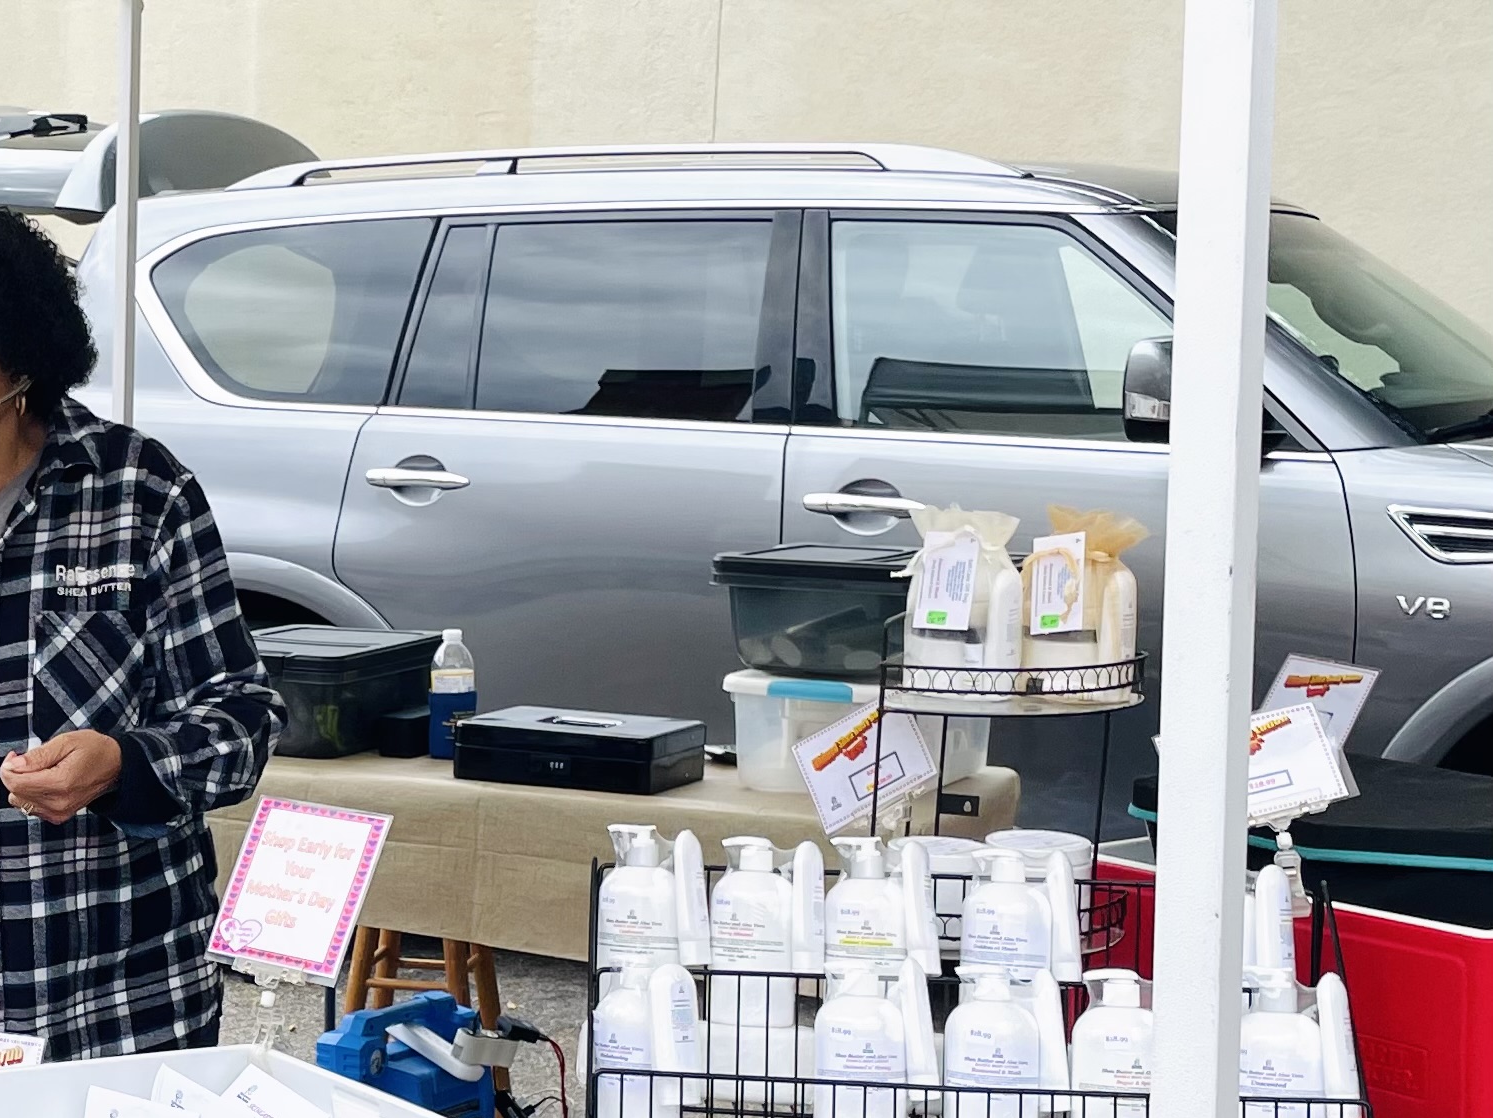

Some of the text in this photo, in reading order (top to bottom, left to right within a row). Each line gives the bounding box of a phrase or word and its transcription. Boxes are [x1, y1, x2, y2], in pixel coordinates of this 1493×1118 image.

[57, 582, 131, 597] SHEA BUTTER
[1396, 595, 1451, 619] V8
[262, 831, 355, 860] Shop Early for
[285, 860, 315, 879] Your
[246, 879, 335, 913] Mother's Day
[265, 909, 297, 928] Gifts
